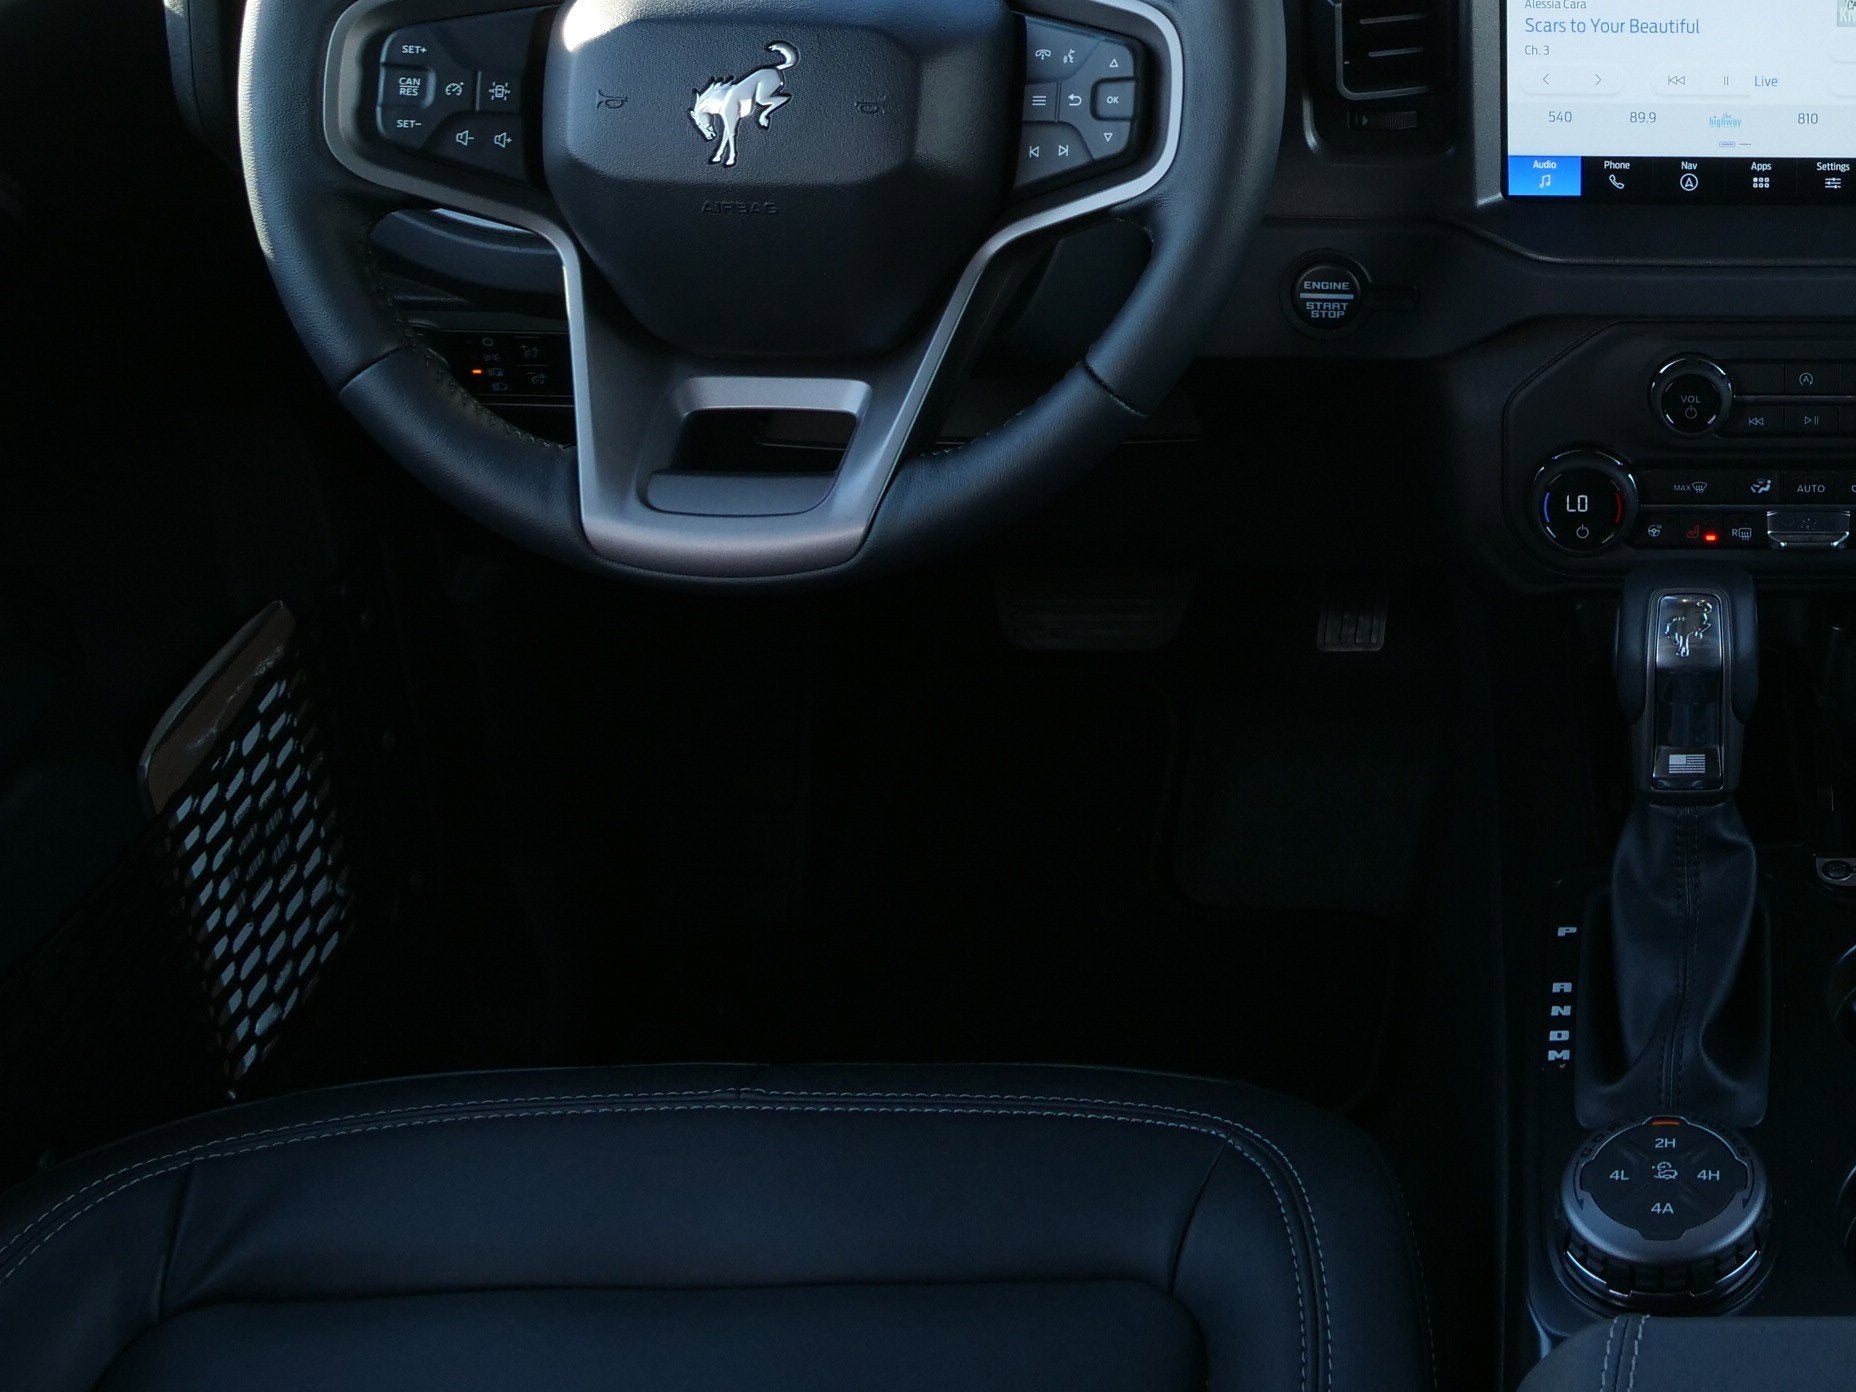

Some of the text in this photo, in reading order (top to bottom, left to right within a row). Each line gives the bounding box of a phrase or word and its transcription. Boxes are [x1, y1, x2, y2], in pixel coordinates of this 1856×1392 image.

[1524, 0, 1587, 10] Alessia Cara
[1525, 18, 1701, 34] Scars to Your Beautiful
[402, 45, 427, 54] SET+
[1524, 45, 1550, 56] Ch. 3
[399, 77, 421, 87] CAN
[1754, 75, 1778, 87] Live
[400, 88, 419, 97] RES
[1106, 96, 1119, 104] OK
[1548, 111, 1573, 123] 540
[1629, 112, 1657, 124] 89.9
[1709, 115, 1742, 128] highway
[1797, 113, 1819, 125] 810
[1533, 160, 1557, 170] Audio
[1604, 160, 1630, 170] Phone
[1681, 161, 1698, 170] Nav
[1750, 161, 1772, 172] Apps
[1817, 161, 1850, 173] Settings
[1304, 281, 1350, 290] ENGINE
[1306, 301, 1349, 311] START
[1311, 310, 1346, 319] STOP
[1681, 395, 1700, 403] VOL
[1673, 483, 1692, 492] MAX
[1797, 484, 1826, 493] AUTO
[1731, 528, 1739, 537] R
[1557, 926, 1577, 937] P
[1551, 1005, 1571, 1016] N
[1548, 1049, 1571, 1061] M
[1654, 1138, 1676, 1149] 2H
[1609, 1170, 1630, 1181] 4L
[1697, 1170, 1720, 1181] 4H
[1650, 1202, 1674, 1214] 4A
